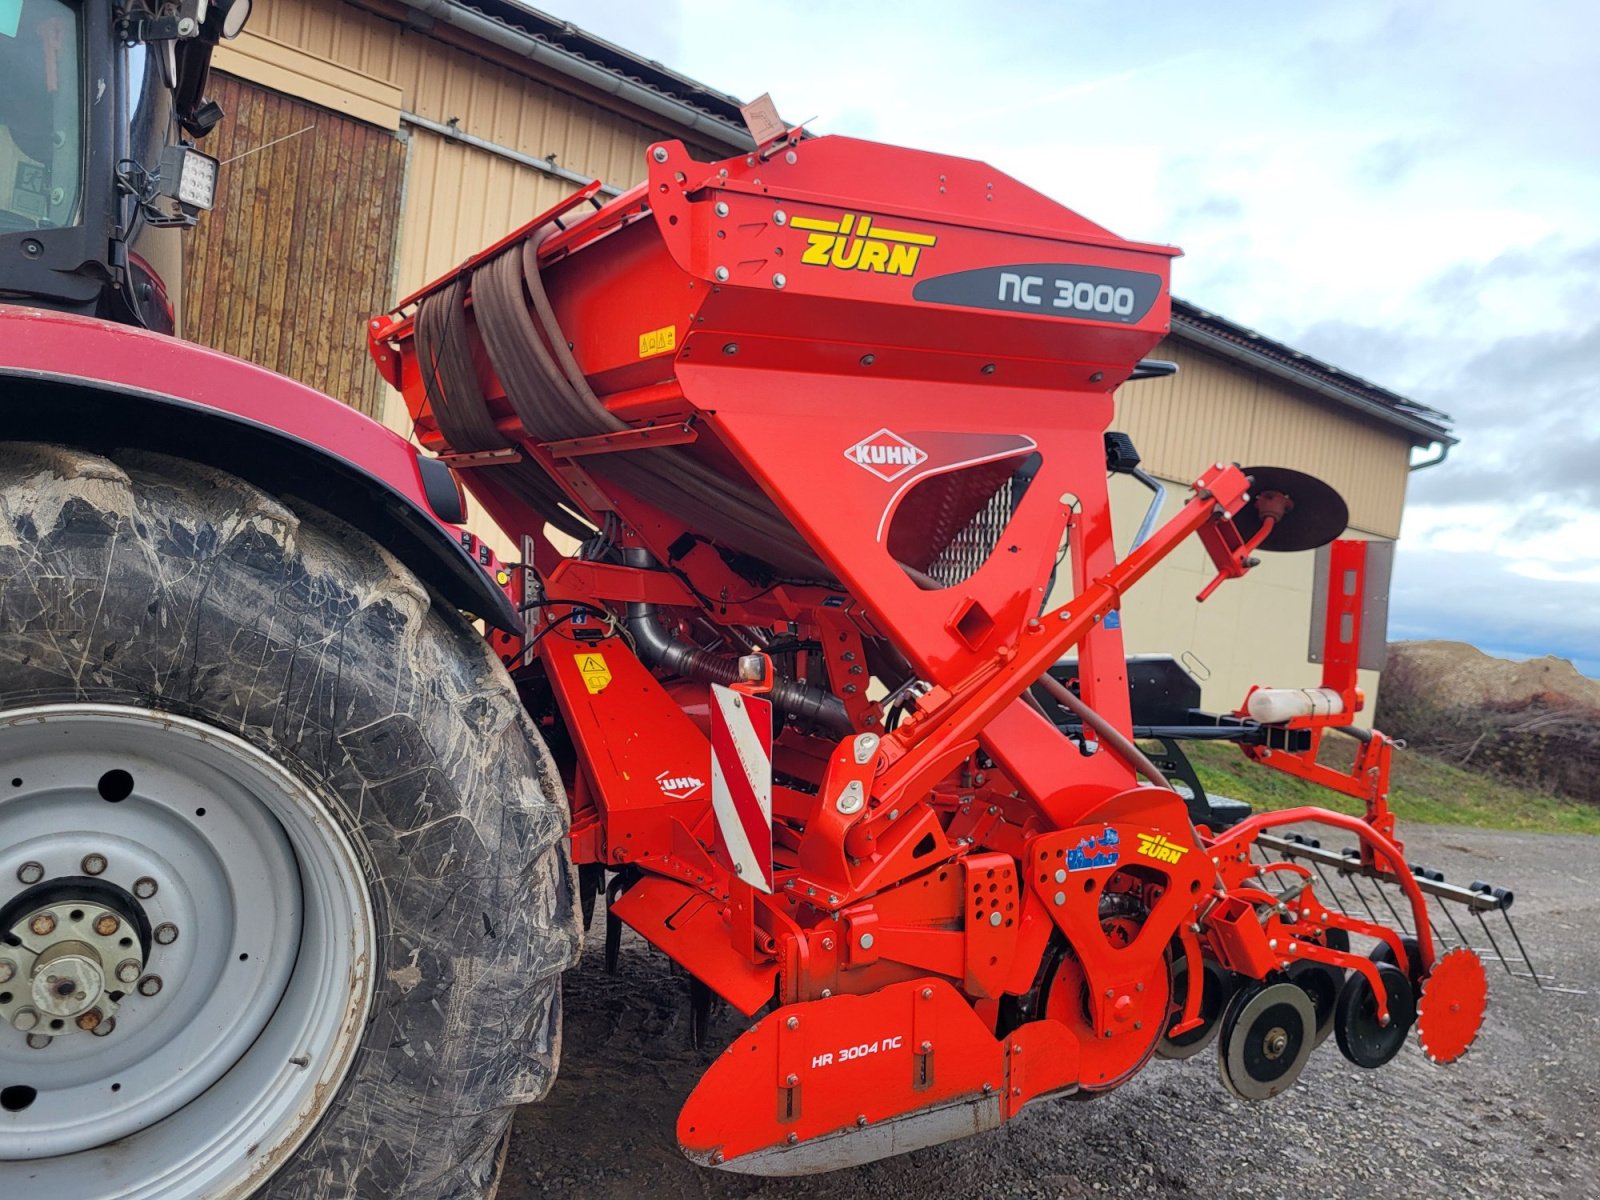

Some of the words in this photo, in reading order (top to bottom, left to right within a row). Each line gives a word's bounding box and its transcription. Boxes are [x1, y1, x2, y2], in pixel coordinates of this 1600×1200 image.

[801, 213, 922, 277] ZÜRN
[1052, 279, 1135, 316] 3000
[855, 445, 917, 466] KUHN
[1137, 834, 1182, 864] ZÜRN
[812, 1053, 833, 1069] HR
[838, 1042, 879, 1062] 3004
